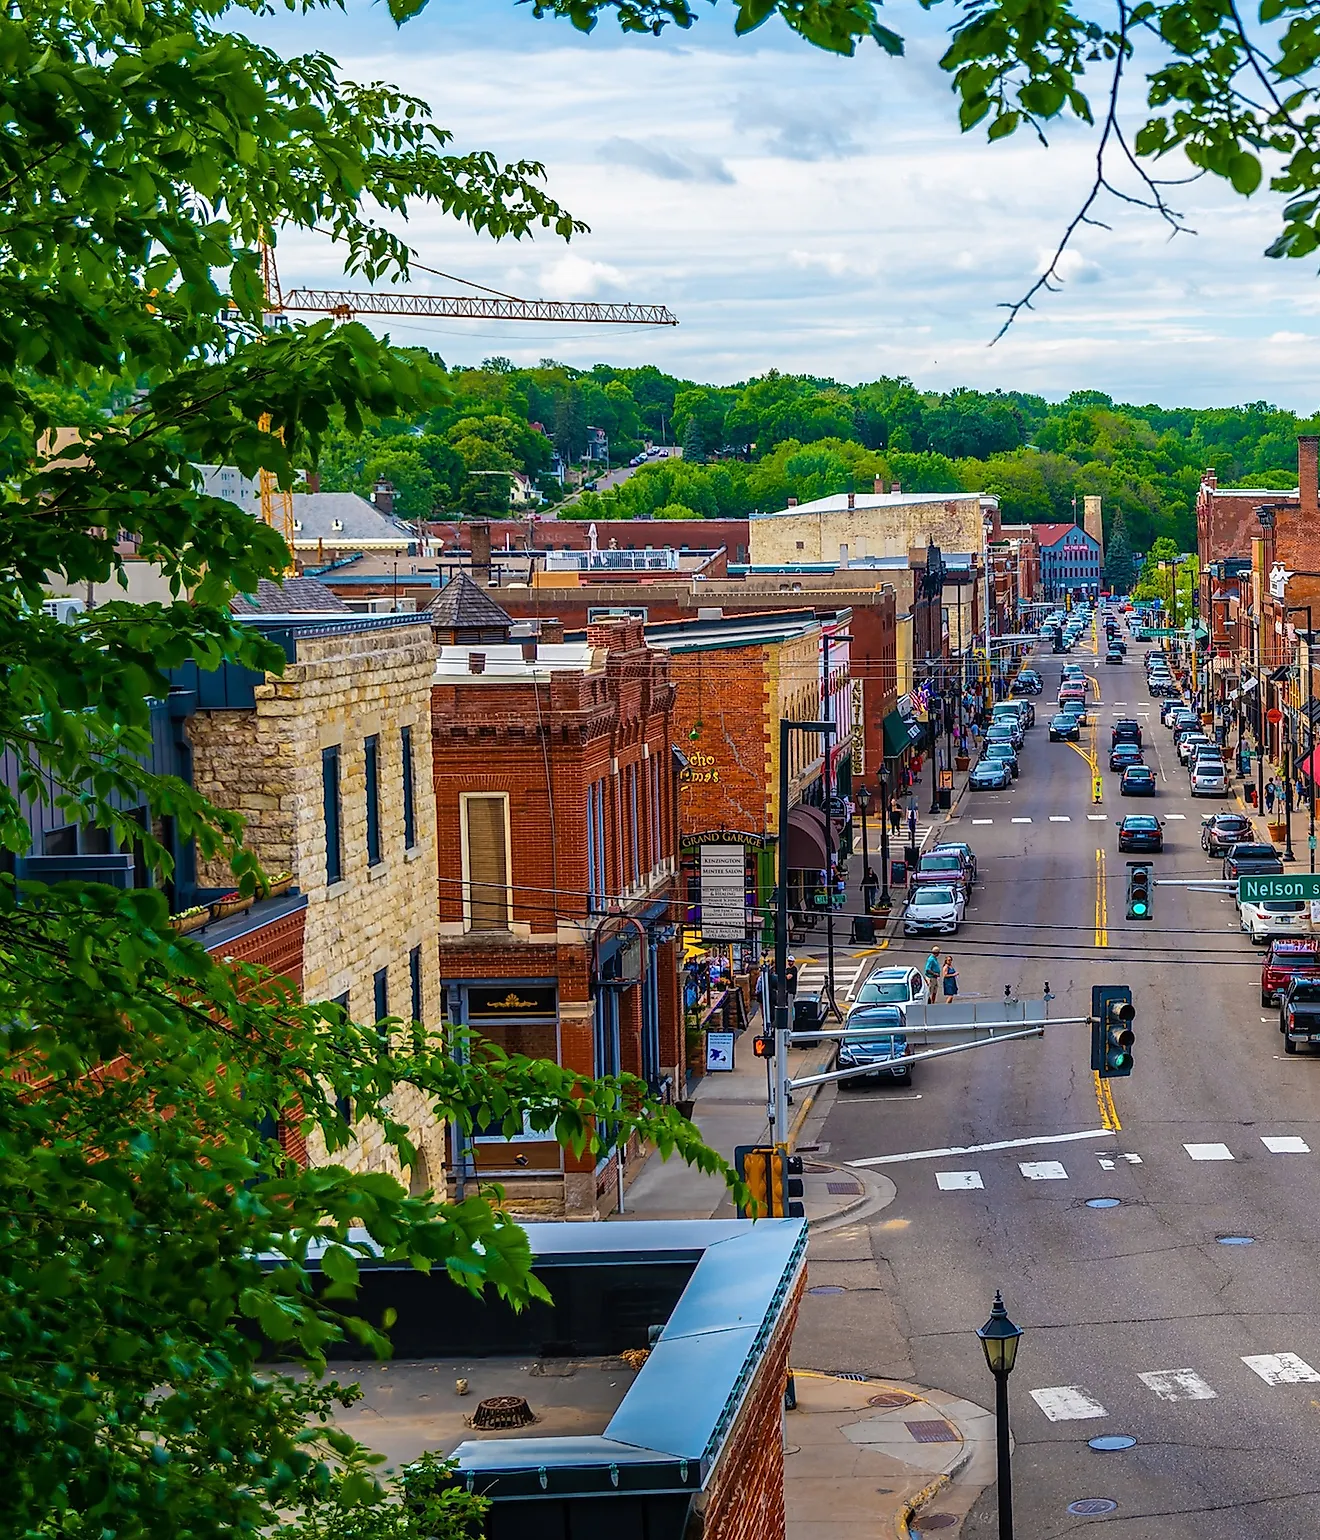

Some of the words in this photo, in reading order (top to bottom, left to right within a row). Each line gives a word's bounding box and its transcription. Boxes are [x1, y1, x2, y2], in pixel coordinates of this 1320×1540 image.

[851, 681, 863, 774] ANTIQUES
[682, 833, 720, 847] GRAND
[722, 832, 762, 848] GARAGE
[1247, 881, 1304, 896] Nelson
